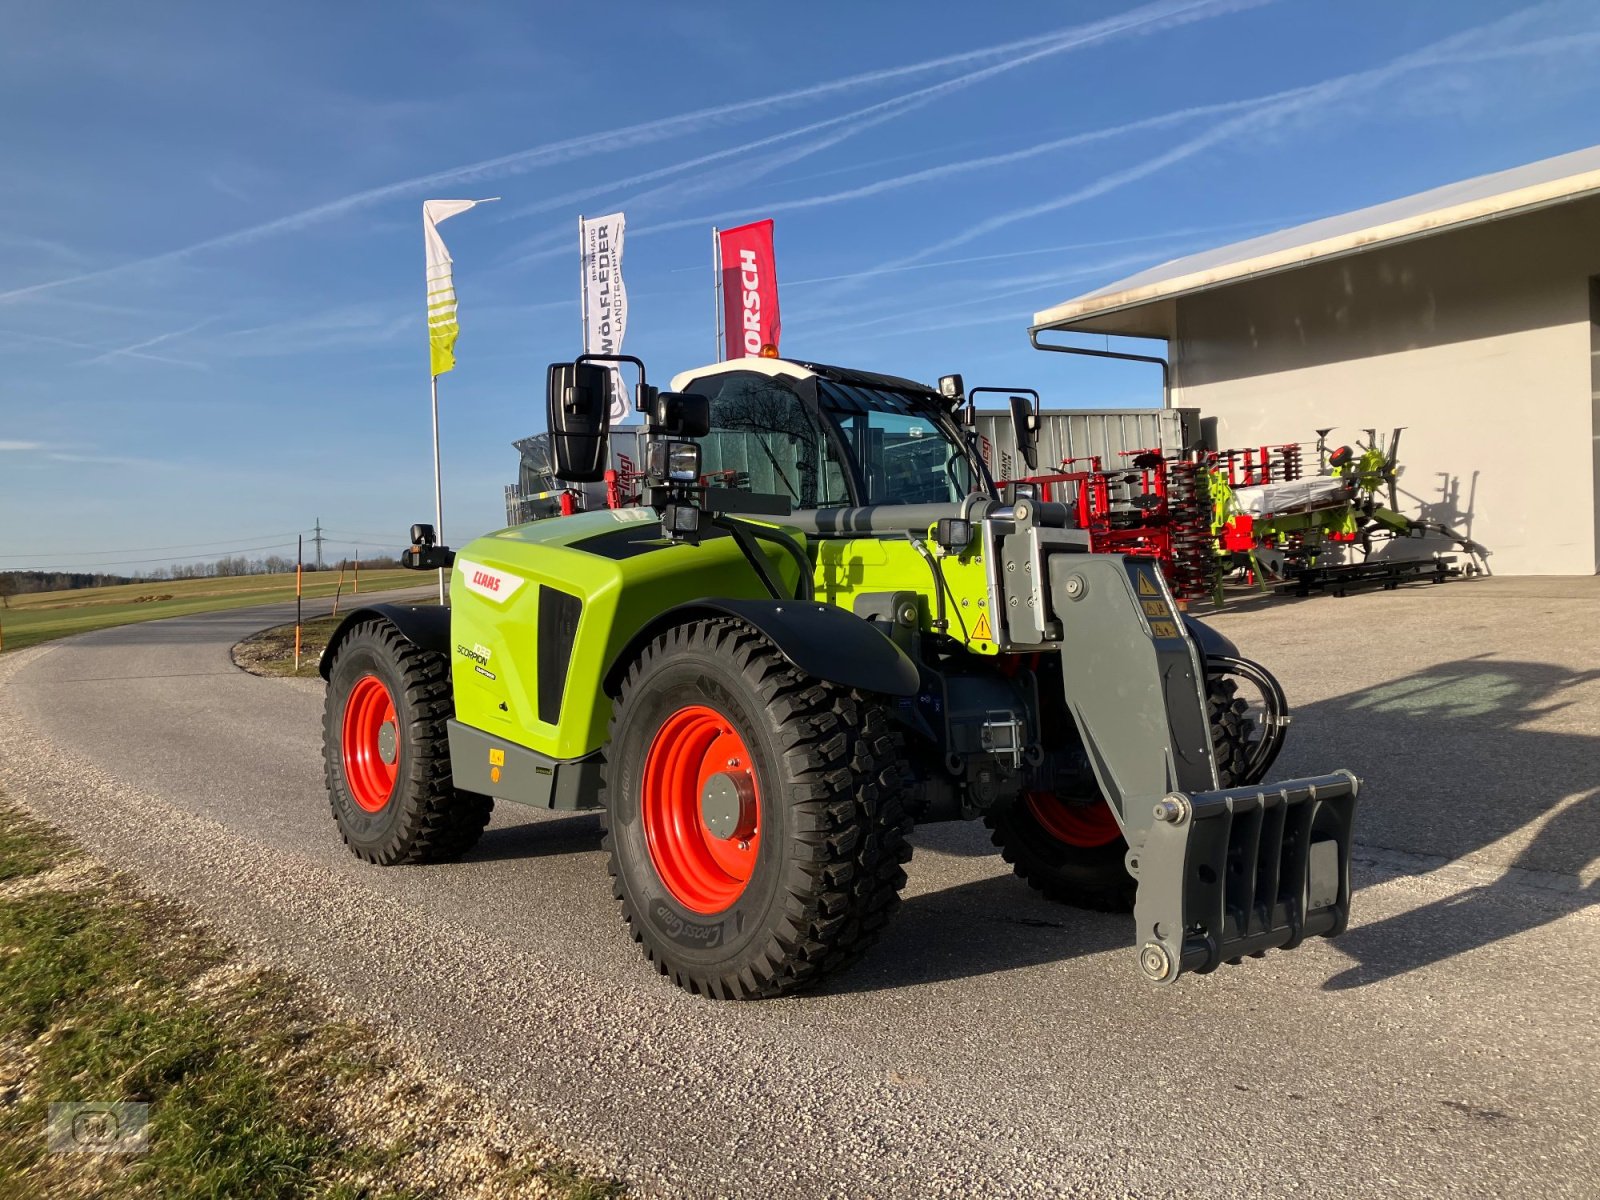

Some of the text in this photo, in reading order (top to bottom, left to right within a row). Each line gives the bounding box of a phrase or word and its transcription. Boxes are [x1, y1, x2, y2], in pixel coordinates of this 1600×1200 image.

[597, 225, 614, 356] WÖLFLEDER
[611, 246, 622, 332] LANDTECHNIK
[740, 249, 761, 359] ORSCH
[473, 571, 501, 592] CLAAS
[457, 644, 488, 666] SCORPION
